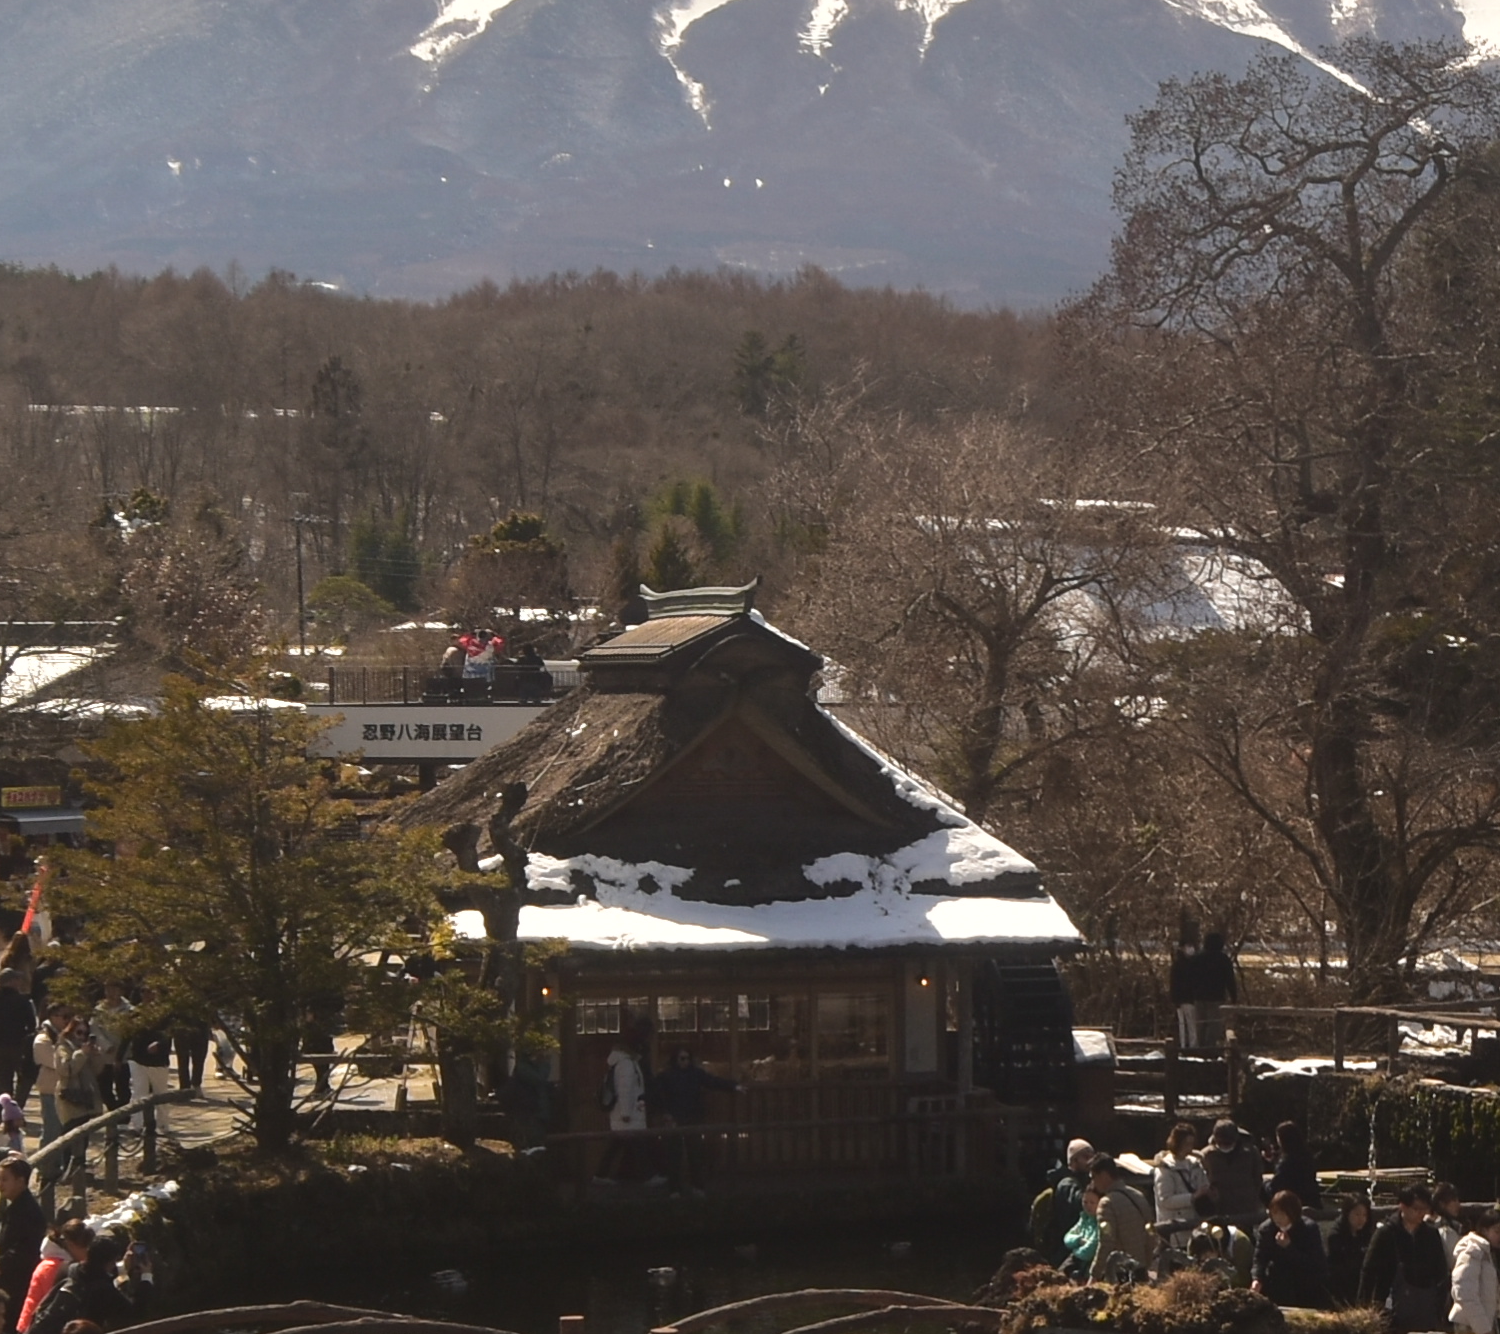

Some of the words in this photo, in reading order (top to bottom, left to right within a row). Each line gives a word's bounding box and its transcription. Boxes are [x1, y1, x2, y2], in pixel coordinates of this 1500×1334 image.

[362, 723, 483, 741] 忍野八海展望台
